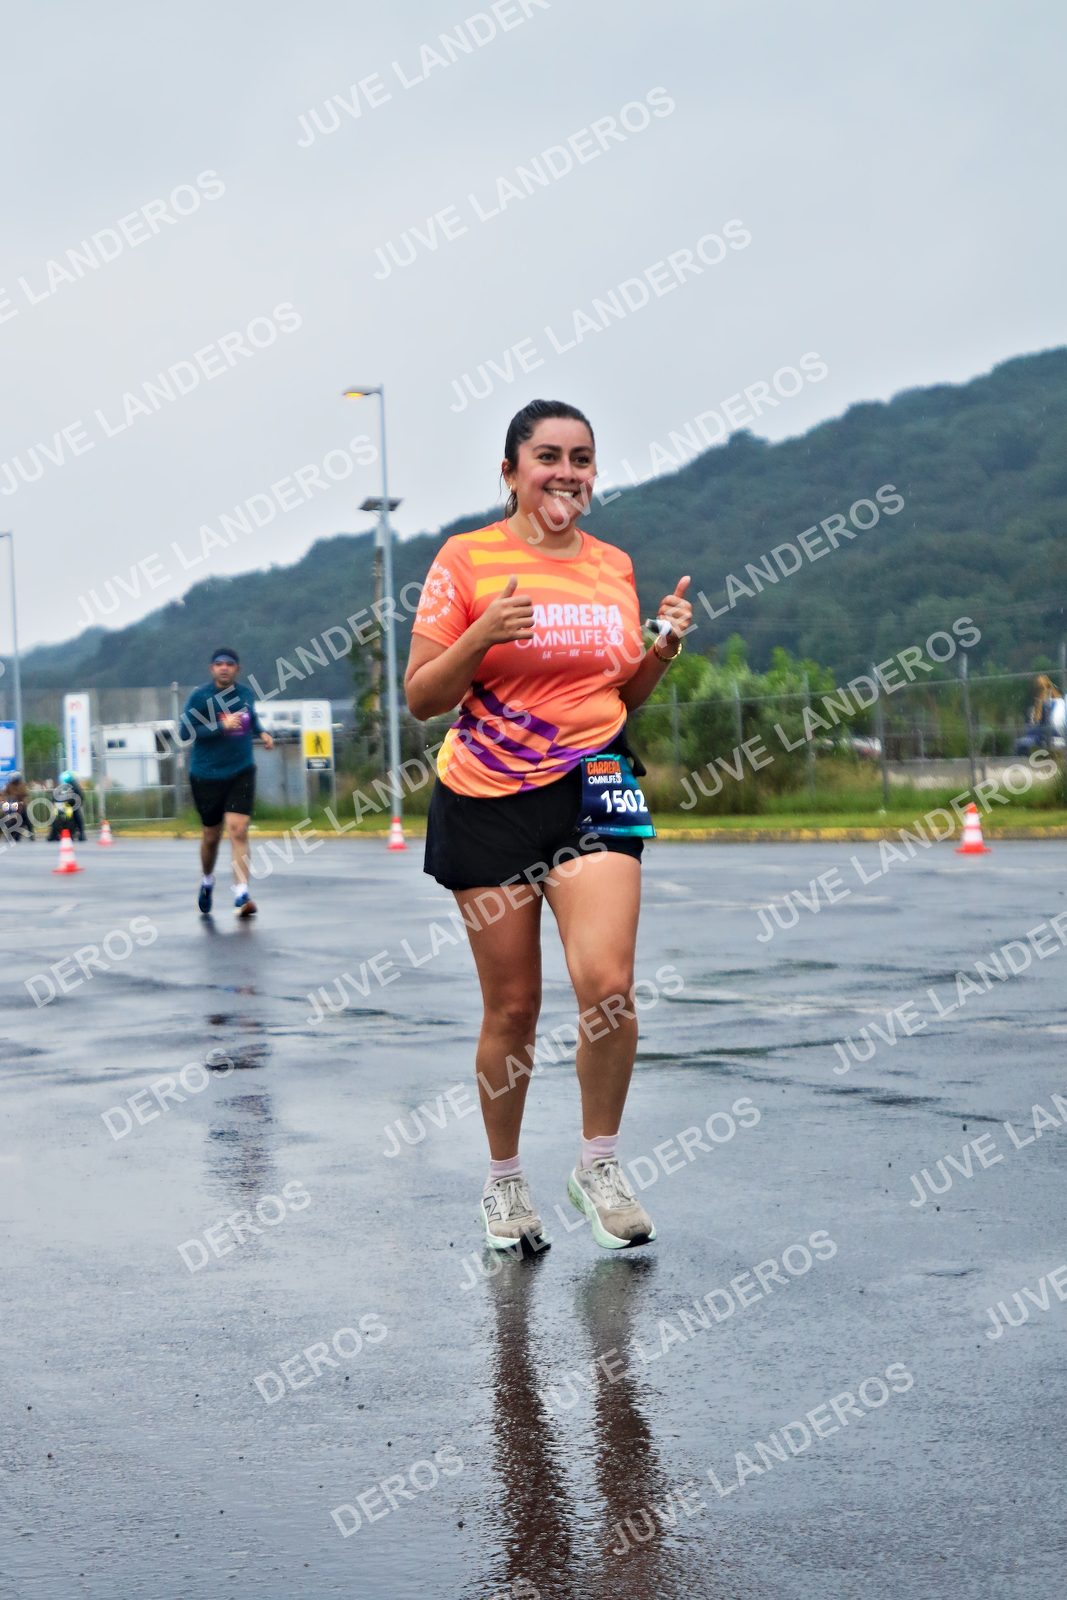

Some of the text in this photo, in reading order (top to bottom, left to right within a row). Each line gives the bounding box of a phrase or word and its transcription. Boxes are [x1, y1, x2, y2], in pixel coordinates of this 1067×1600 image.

[531, 603, 623, 628] ARRERA
[587, 761, 621, 775] CARRERA
[601, 789, 648, 812] 1502
